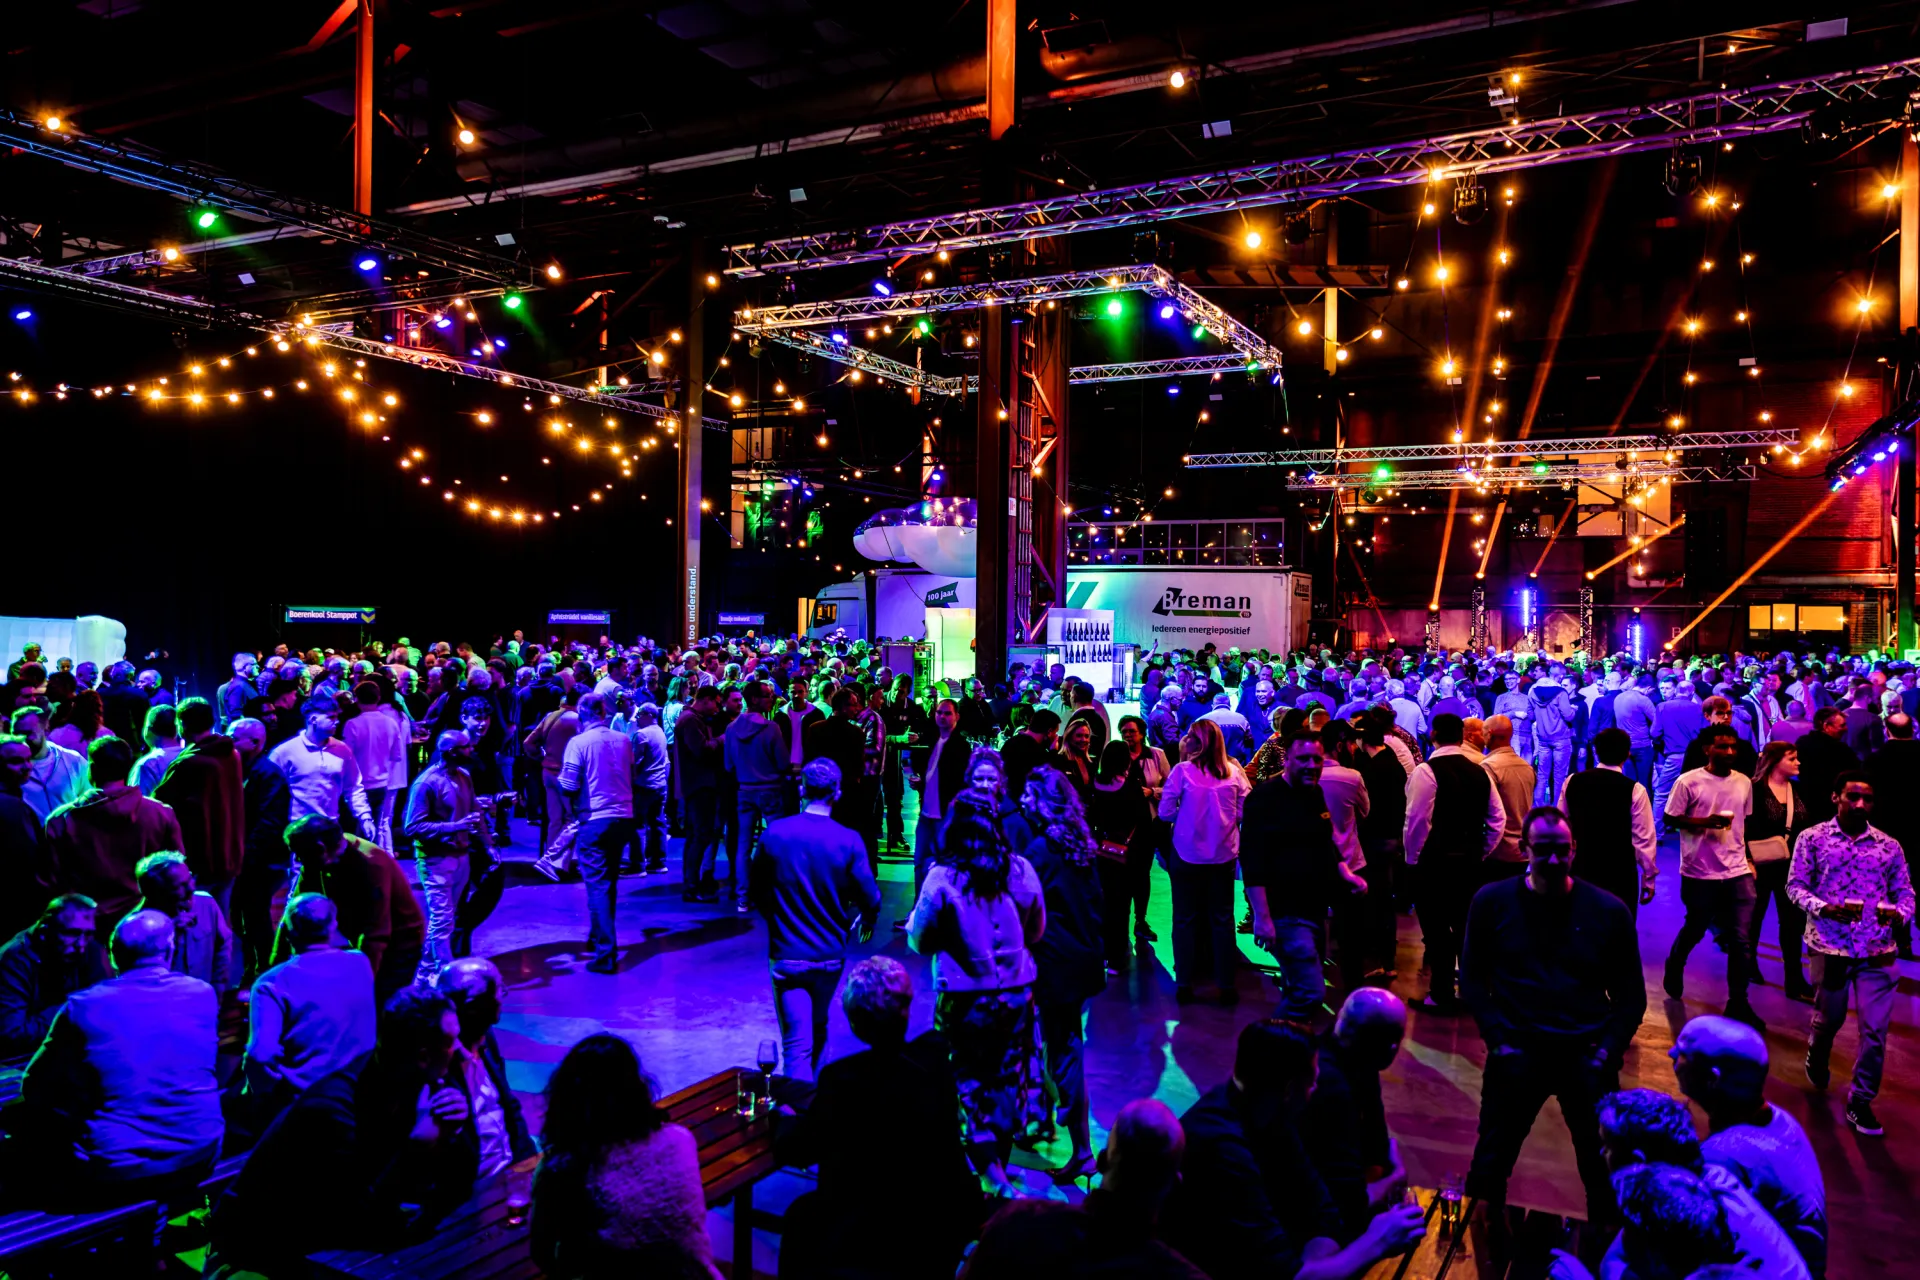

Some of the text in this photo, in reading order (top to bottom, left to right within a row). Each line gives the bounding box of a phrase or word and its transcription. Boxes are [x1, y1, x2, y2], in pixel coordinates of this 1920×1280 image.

[688, 565, 697, 622] understand.
[927, 590, 954, 601] 100 jaar
[1162, 590, 1251, 610] Breman
[289, 610, 358, 621] Boerenkool Stamppot
[688, 624, 696, 640] too
[1152, 625, 1251, 636] Iedereen energiepositief
